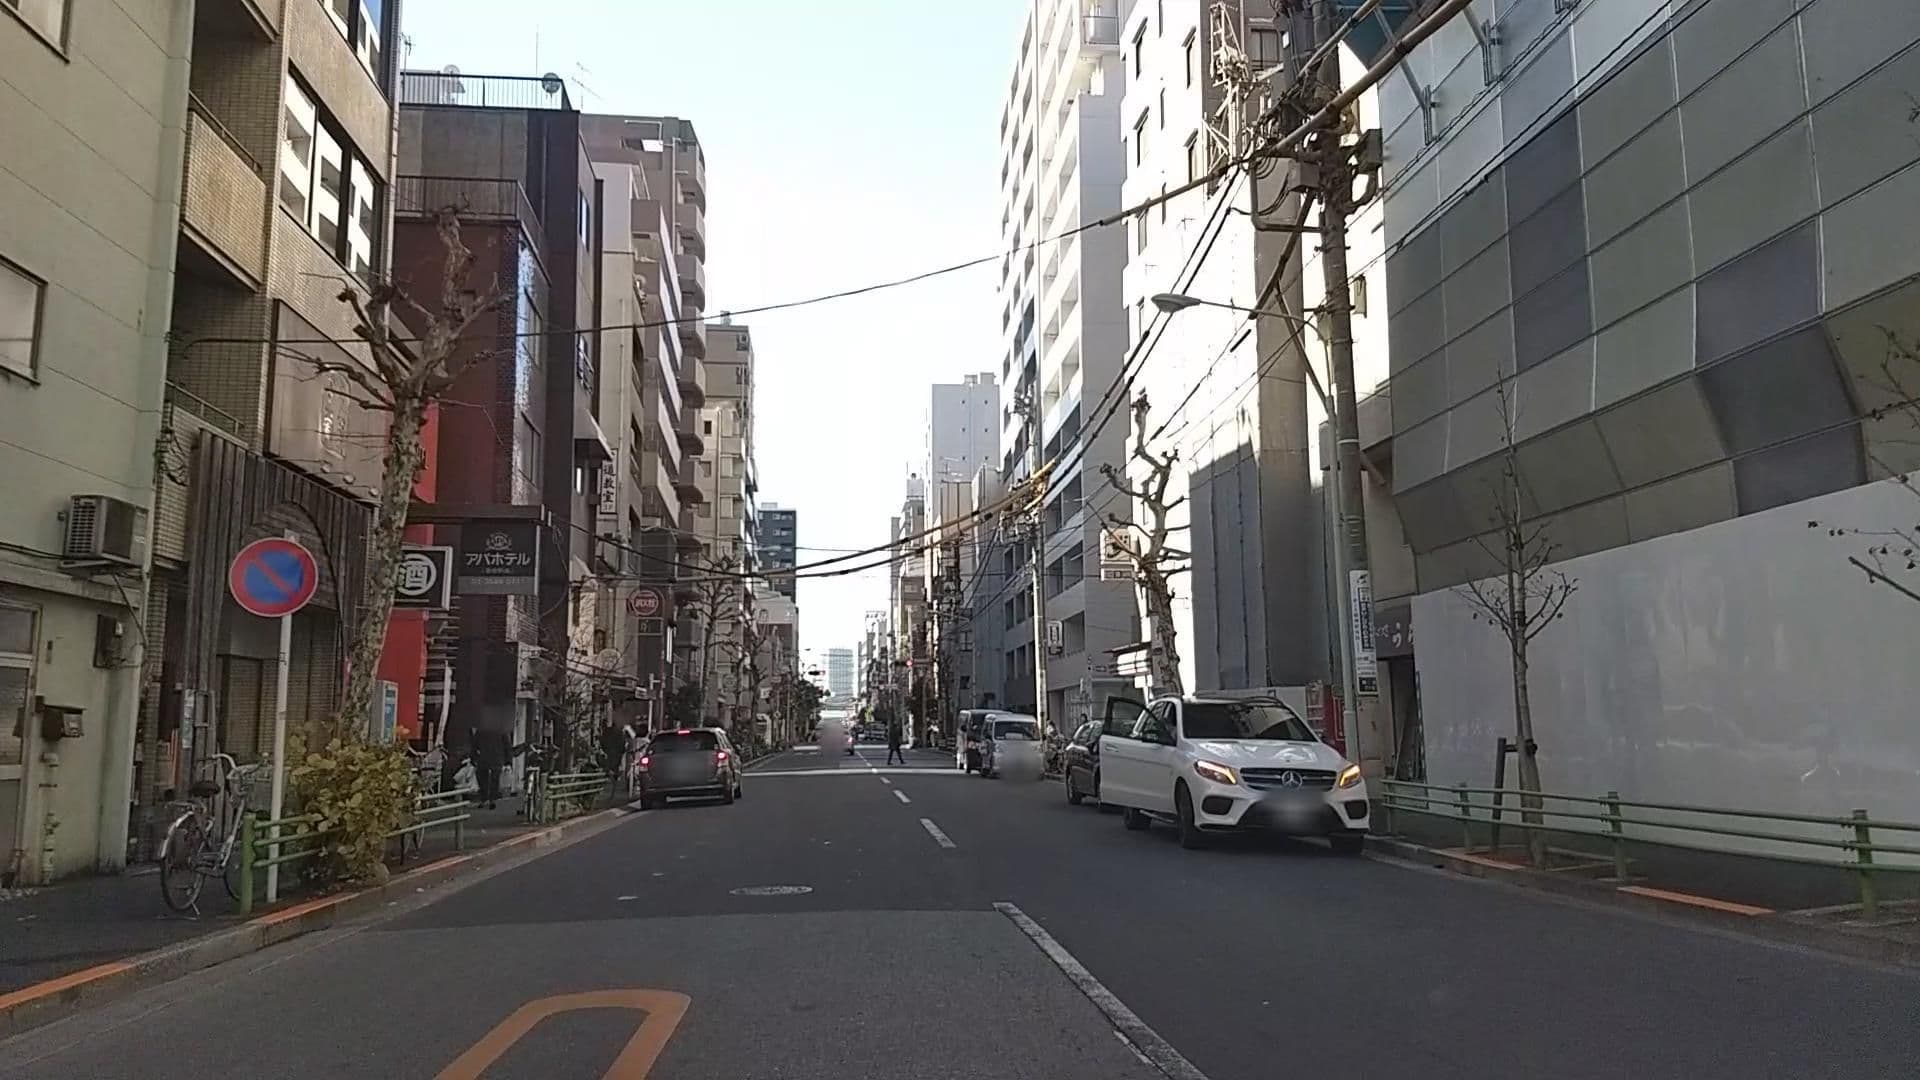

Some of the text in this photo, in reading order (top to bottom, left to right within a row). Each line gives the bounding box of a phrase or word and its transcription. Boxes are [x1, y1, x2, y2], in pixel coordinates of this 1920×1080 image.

[602, 450, 617, 503] 道教室
[465, 552, 531, 566] アパホテル
[396, 560, 428, 588] 酒
